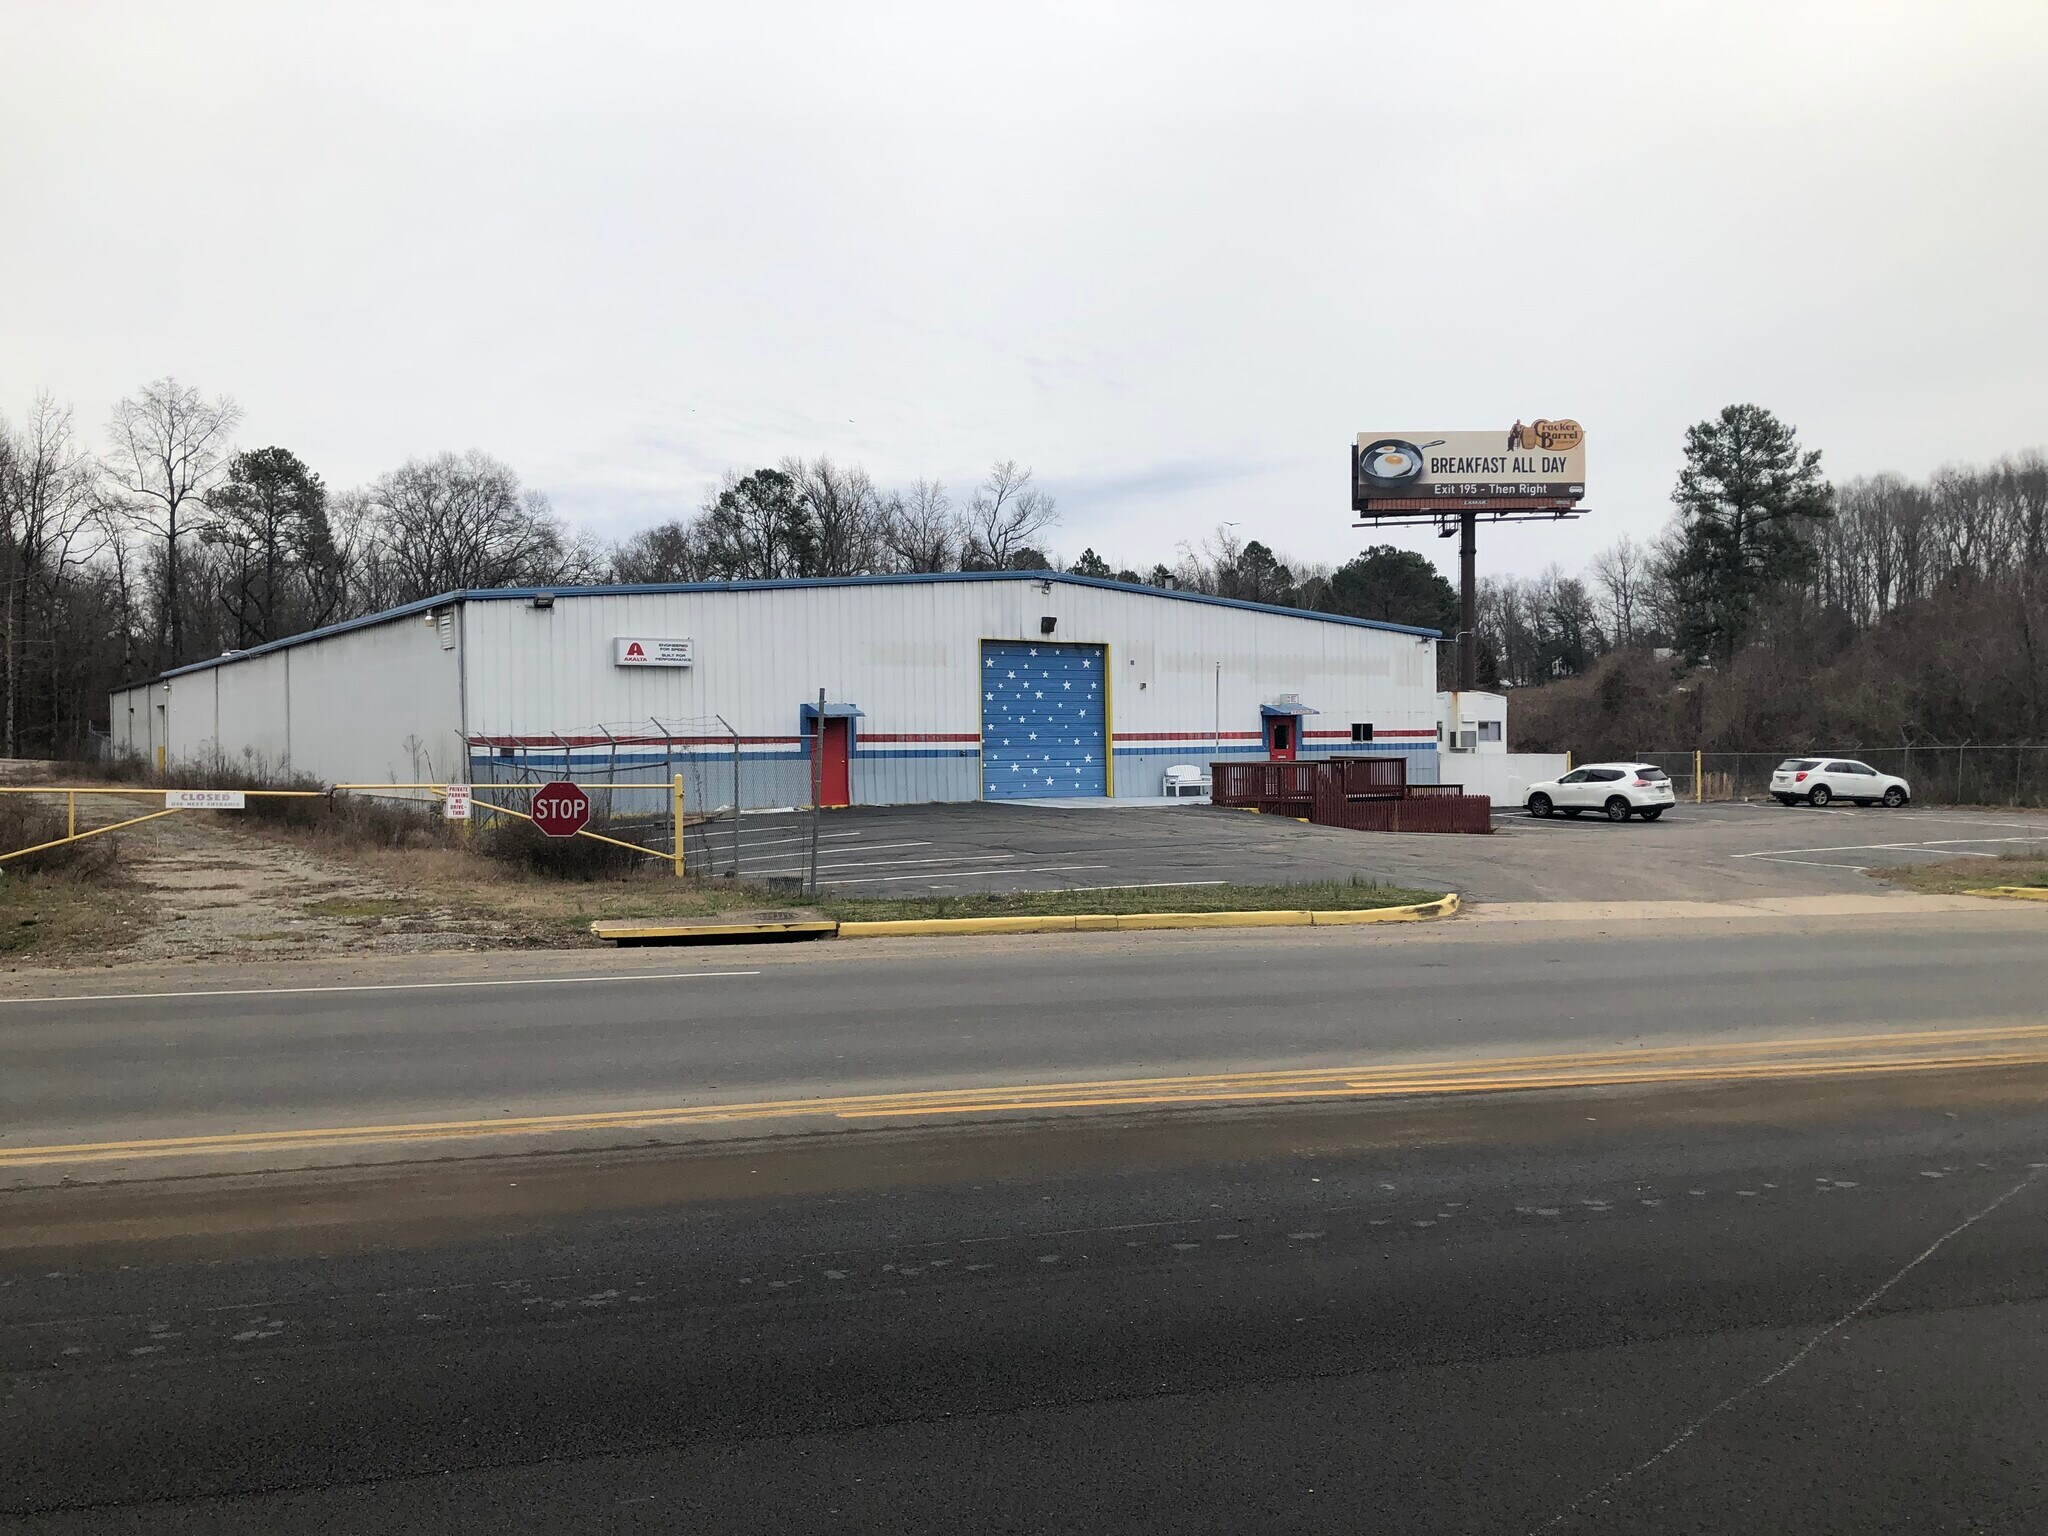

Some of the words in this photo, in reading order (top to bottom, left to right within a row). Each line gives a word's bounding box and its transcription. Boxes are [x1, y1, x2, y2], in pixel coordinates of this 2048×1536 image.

[1534, 420, 1577, 437] Cracker
[1541, 431, 1578, 448] Barrel
[1431, 457, 1507, 474] BREAKFAST
[1512, 457, 1536, 473] ALL
[1542, 457, 1567, 473] DAY
[1434, 484, 1455, 495] Exit
[1459, 484, 1477, 494] 195
[1489, 484, 1515, 494] Then
[1519, 484, 1547, 496] Right
[180, 793, 231, 801] CLOSED
[536, 798, 586, 819] STOP
